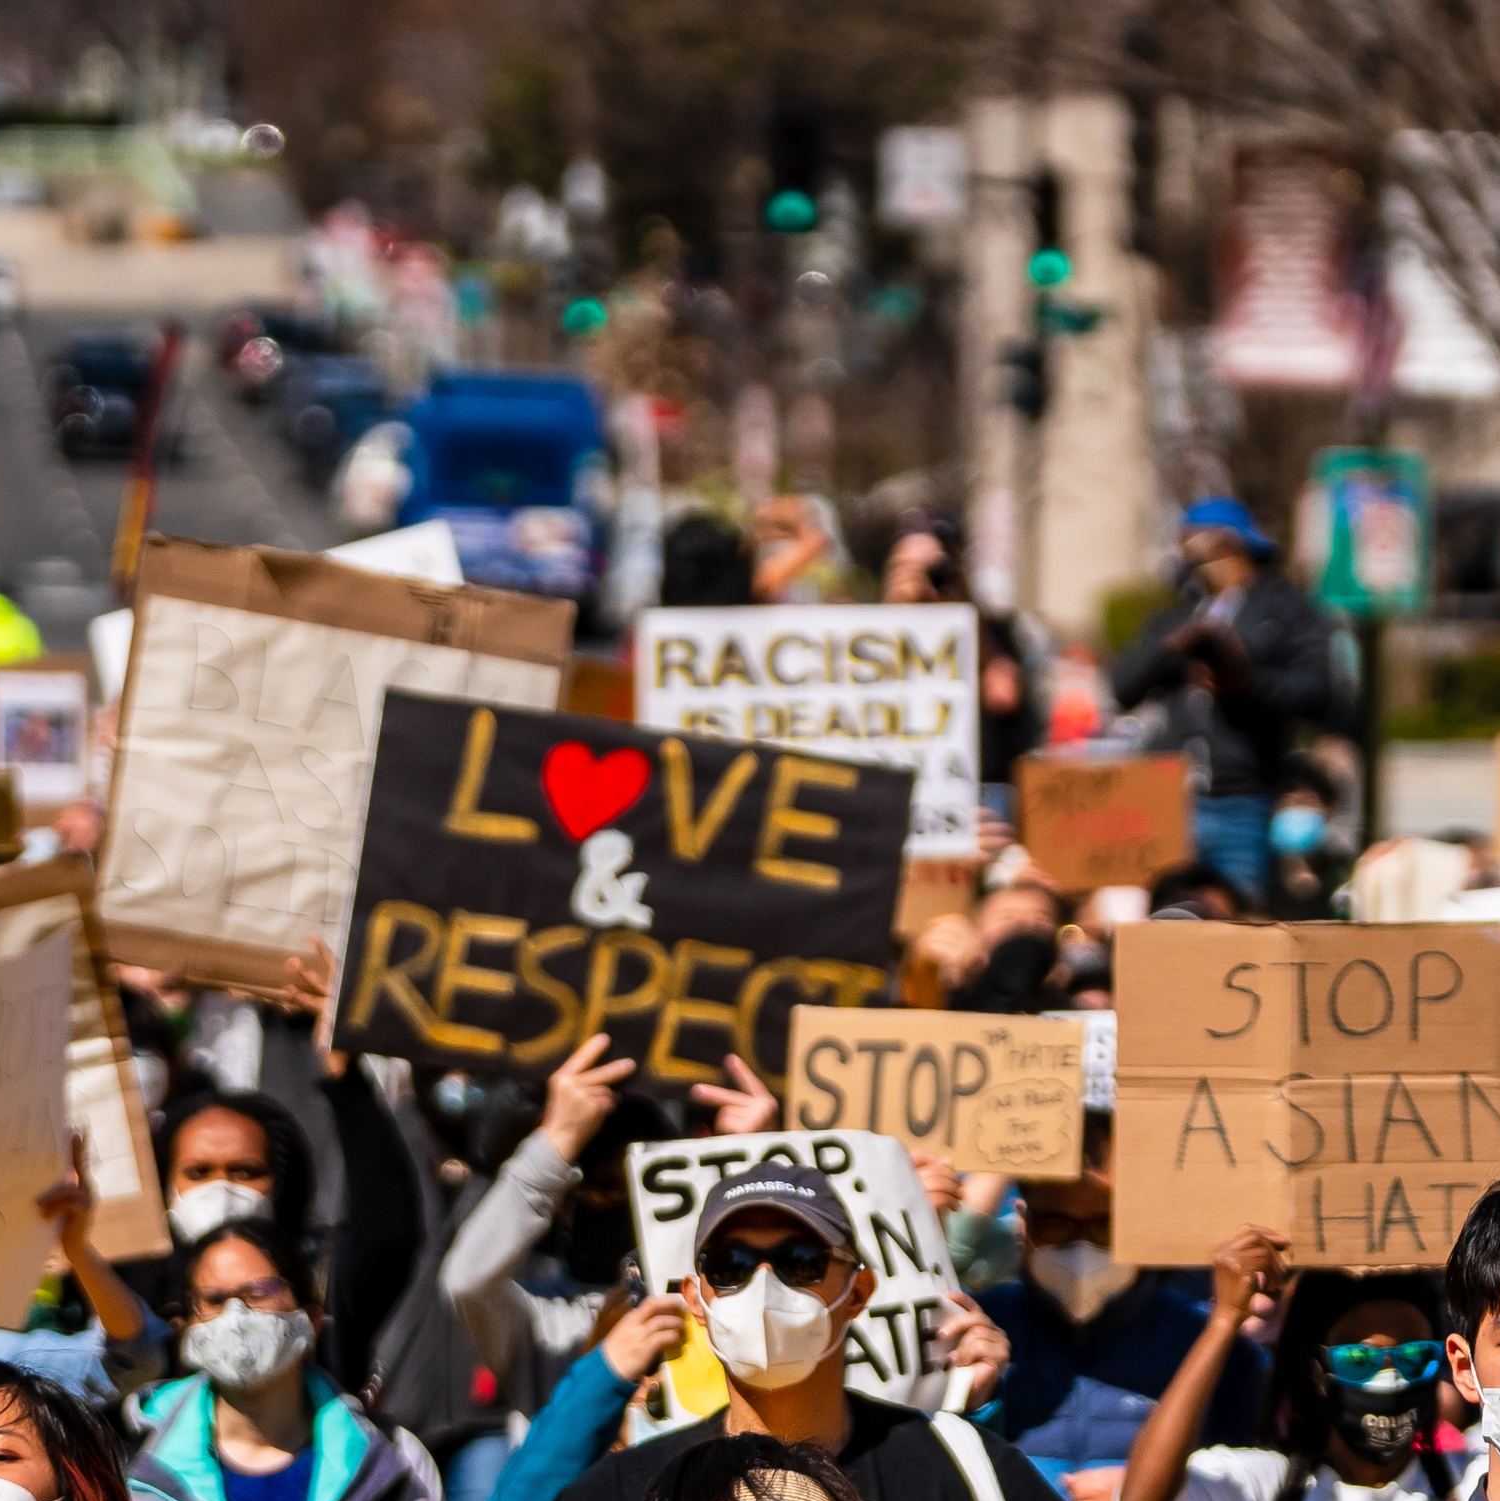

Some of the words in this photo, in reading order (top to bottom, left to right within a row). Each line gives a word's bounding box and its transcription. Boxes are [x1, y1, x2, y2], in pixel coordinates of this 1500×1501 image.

[655, 631, 960, 689] RACISM
[745, 699, 953, 741] DEADLY
[570, 829, 653, 930] &
[1205, 951, 1464, 1046] STOP
[800, 1035, 991, 1149] STOP
[1313, 1177, 1481, 1255] HAT
